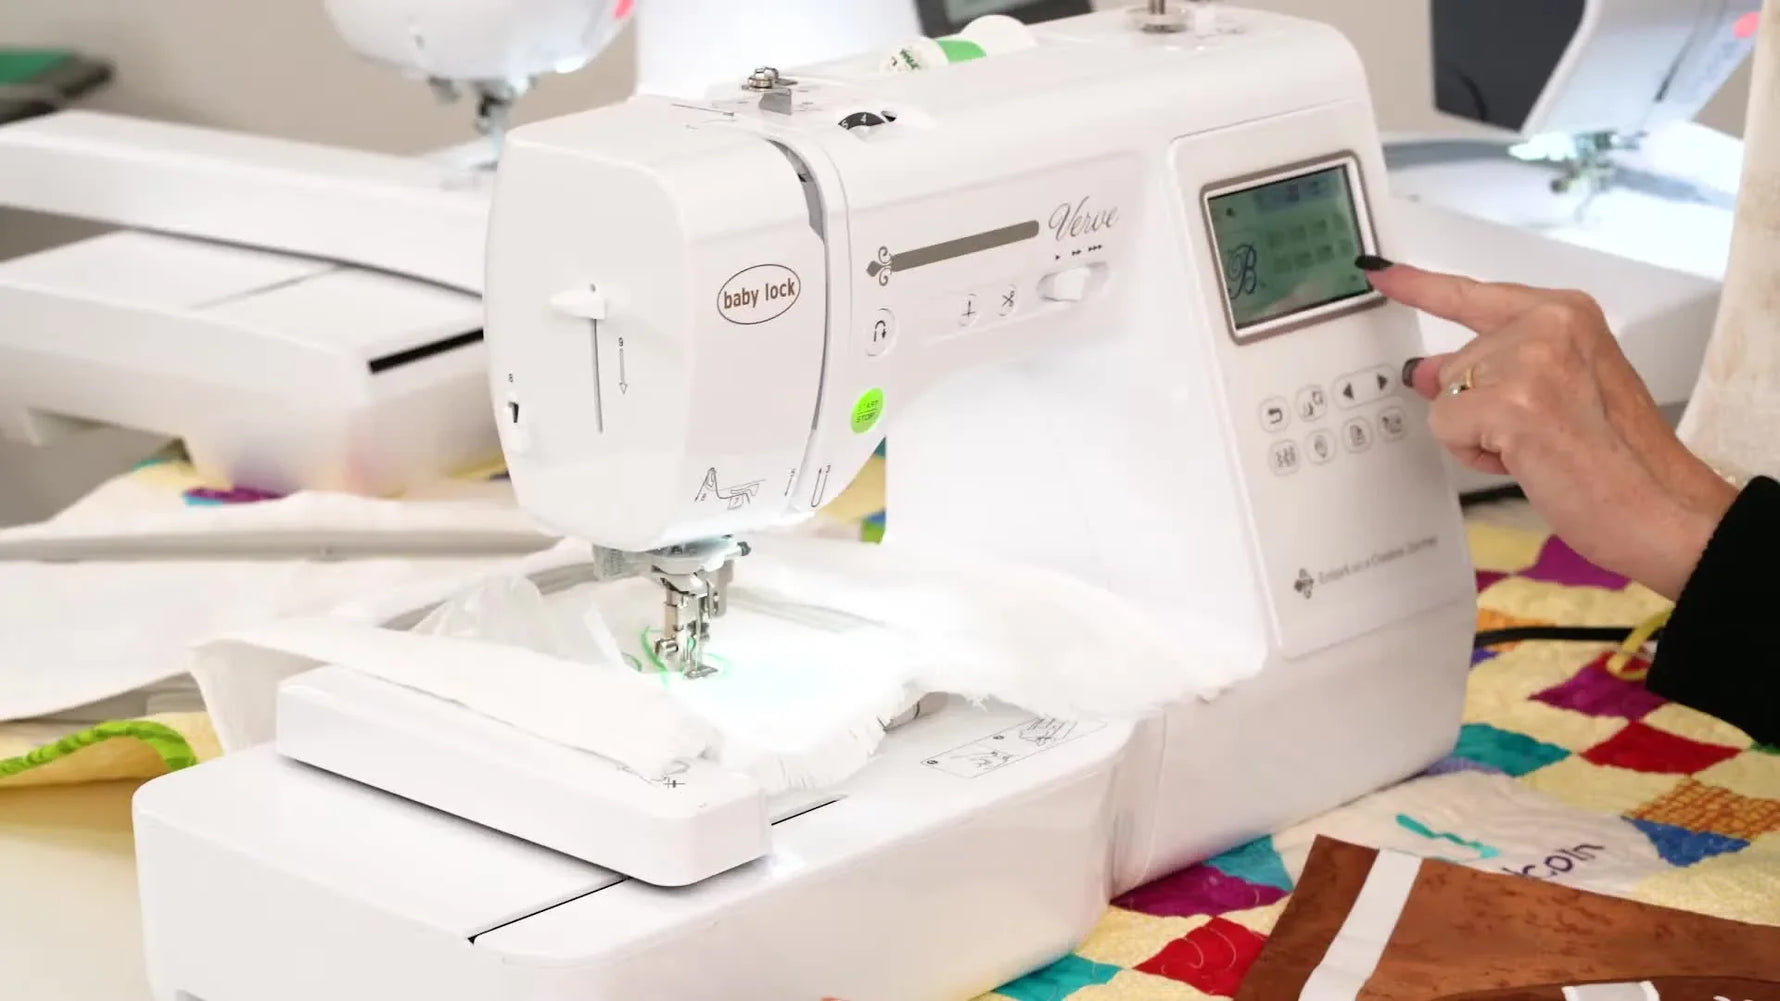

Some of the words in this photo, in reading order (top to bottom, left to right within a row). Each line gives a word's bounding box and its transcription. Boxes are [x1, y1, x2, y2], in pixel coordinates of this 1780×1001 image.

[860, 113, 867, 124] 4
[1047, 195, 1119, 242] Verve
[1227, 243, 1258, 301] B
[723, 287, 759, 309] baby
[765, 277, 796, 301] lock
